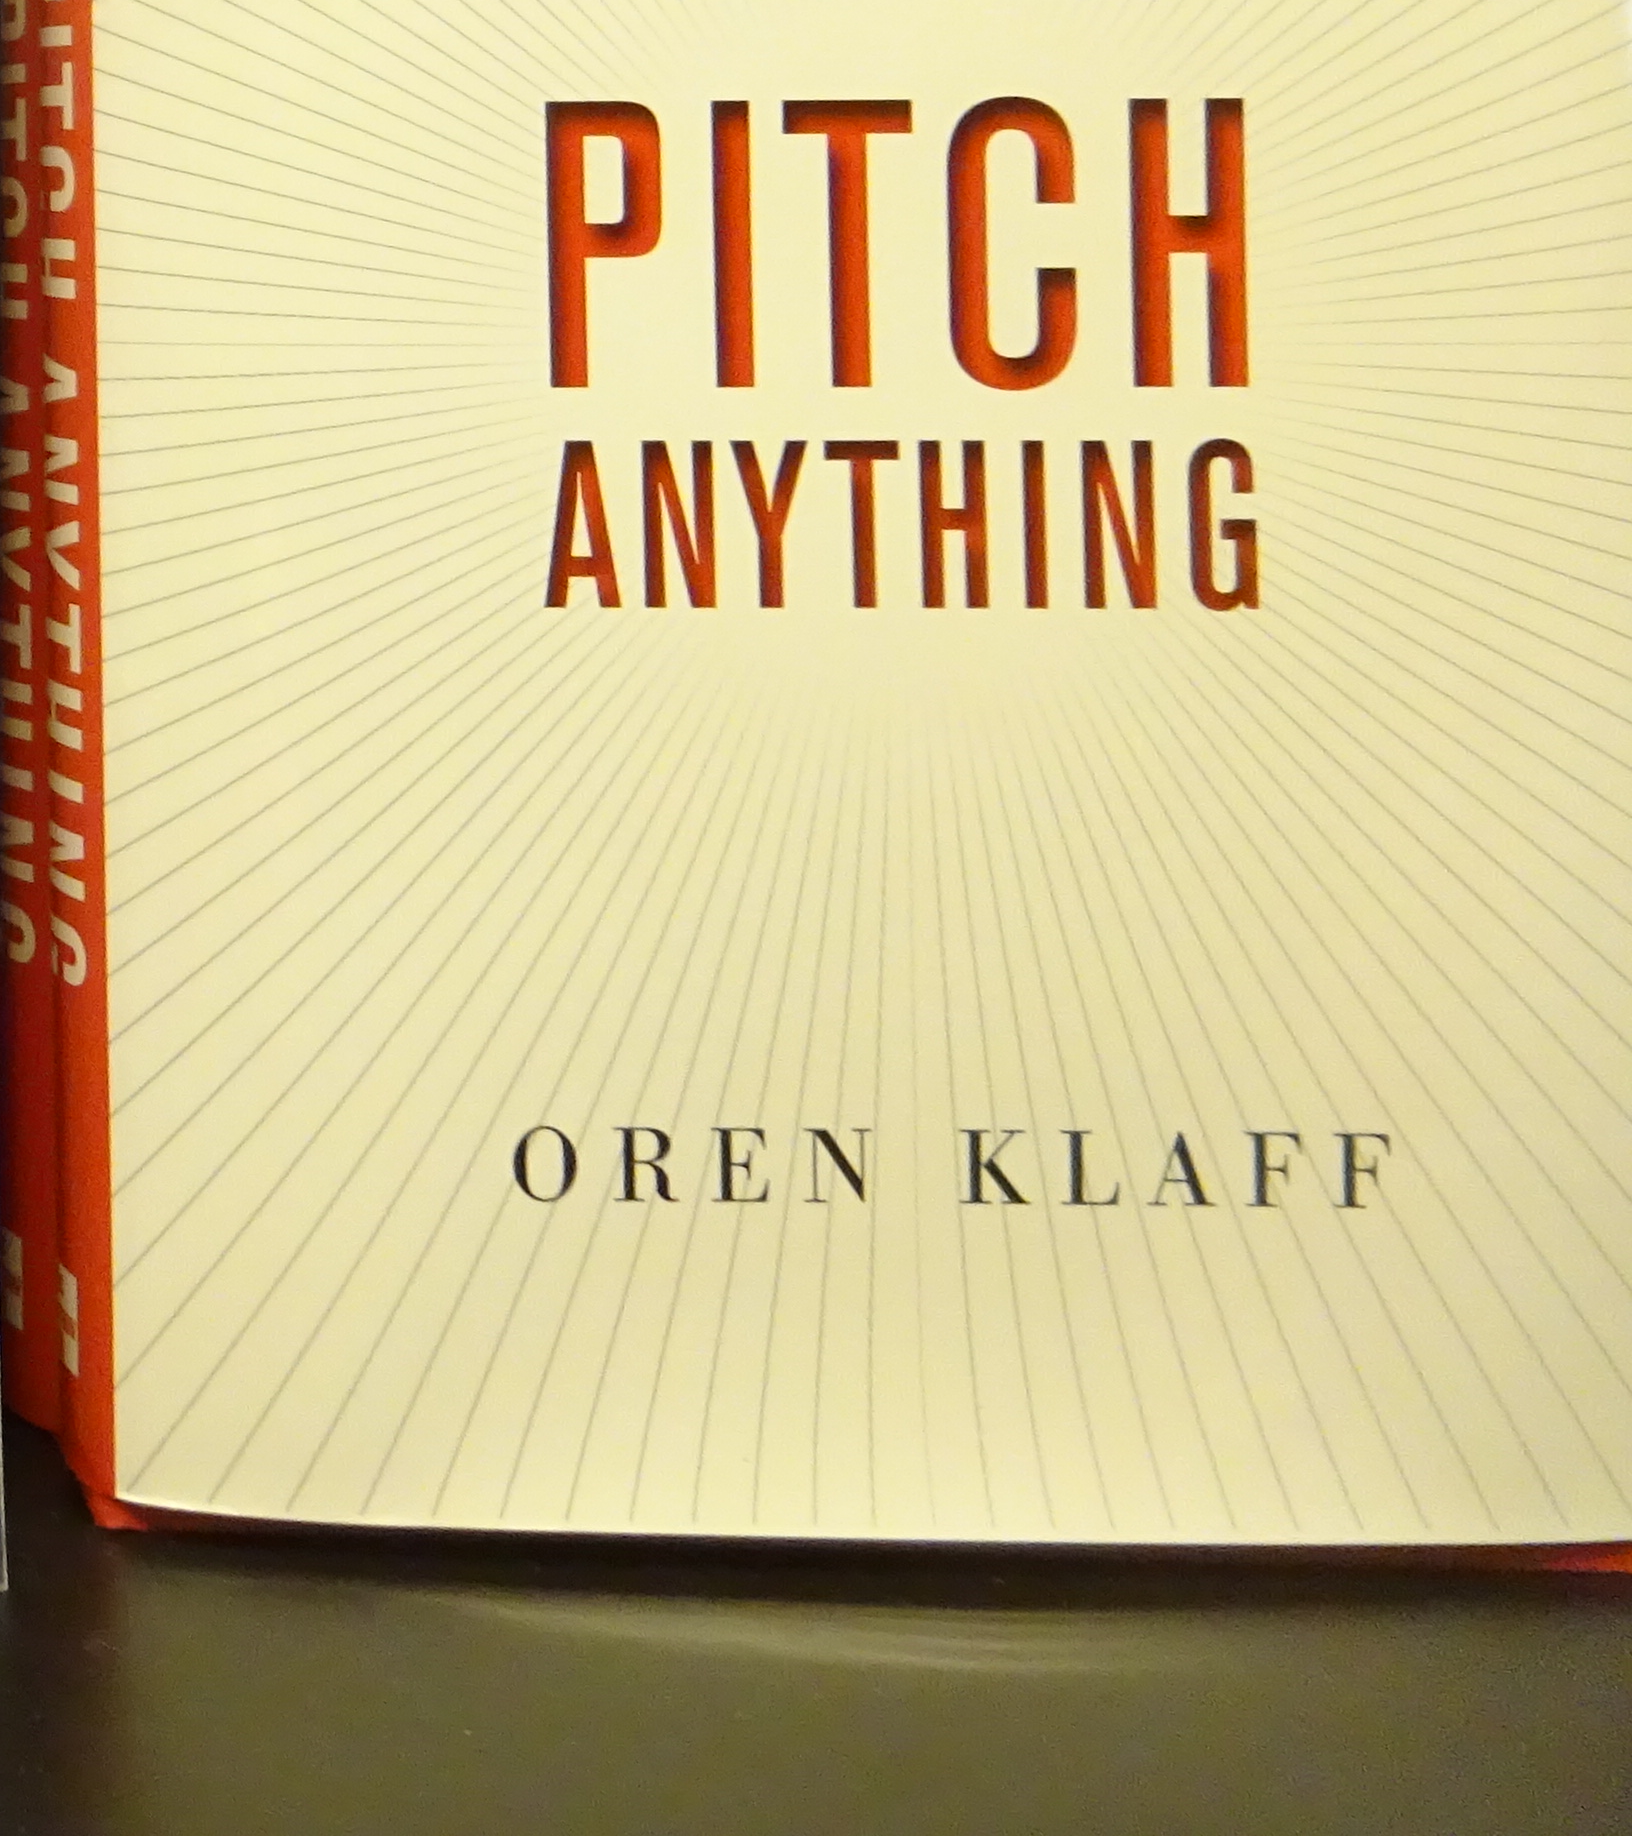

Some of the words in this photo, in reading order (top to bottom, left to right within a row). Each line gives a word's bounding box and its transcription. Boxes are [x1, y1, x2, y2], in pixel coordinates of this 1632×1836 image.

[540, 95, 1252, 391] PITCH
[538, 435, 1264, 615] ANYTHING
[512, 1123, 874, 1204] OREN
[958, 1128, 1396, 1211] KLAFF
